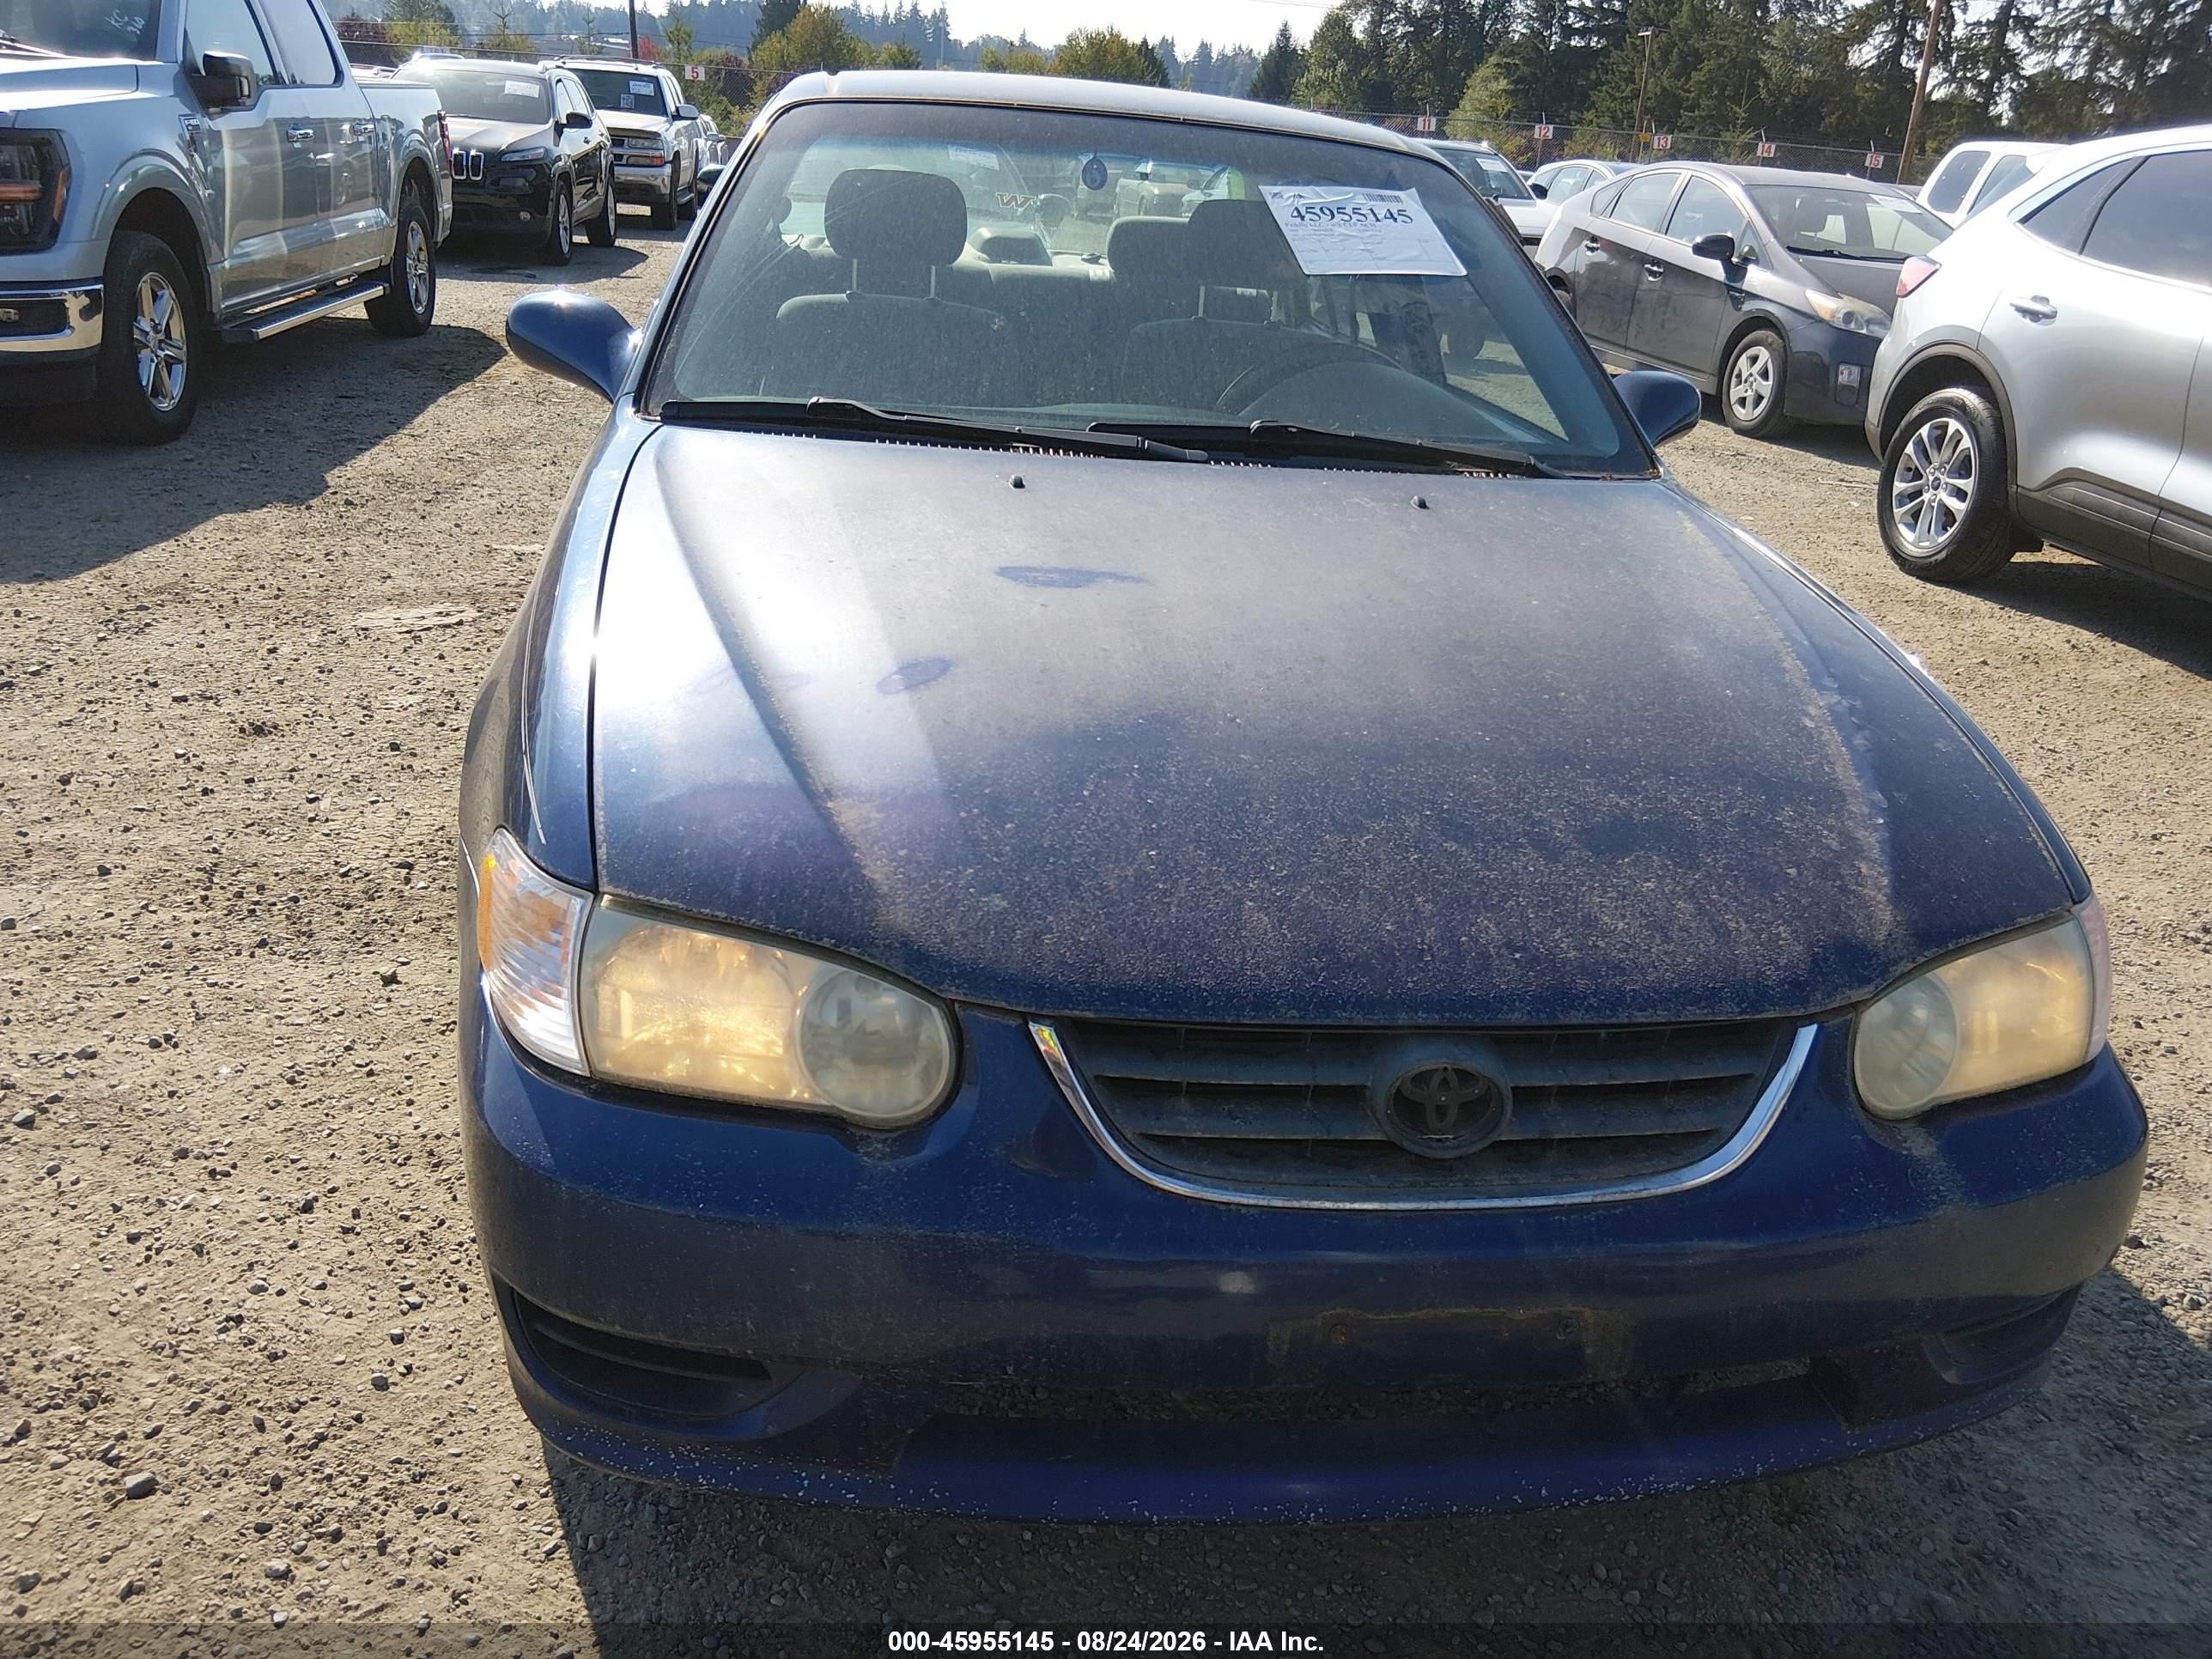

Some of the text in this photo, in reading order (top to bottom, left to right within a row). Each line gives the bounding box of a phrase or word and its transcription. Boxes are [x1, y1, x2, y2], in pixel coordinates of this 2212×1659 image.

[690, 66, 700, 80] 5
[1421, 117, 1431, 131] 11
[1537, 126, 1550, 138] 12
[1656, 136, 1668, 149] 13
[1760, 143, 1772, 156] 14
[1869, 155, 1880, 167] 15
[1290, 206, 1413, 224] 45955145
